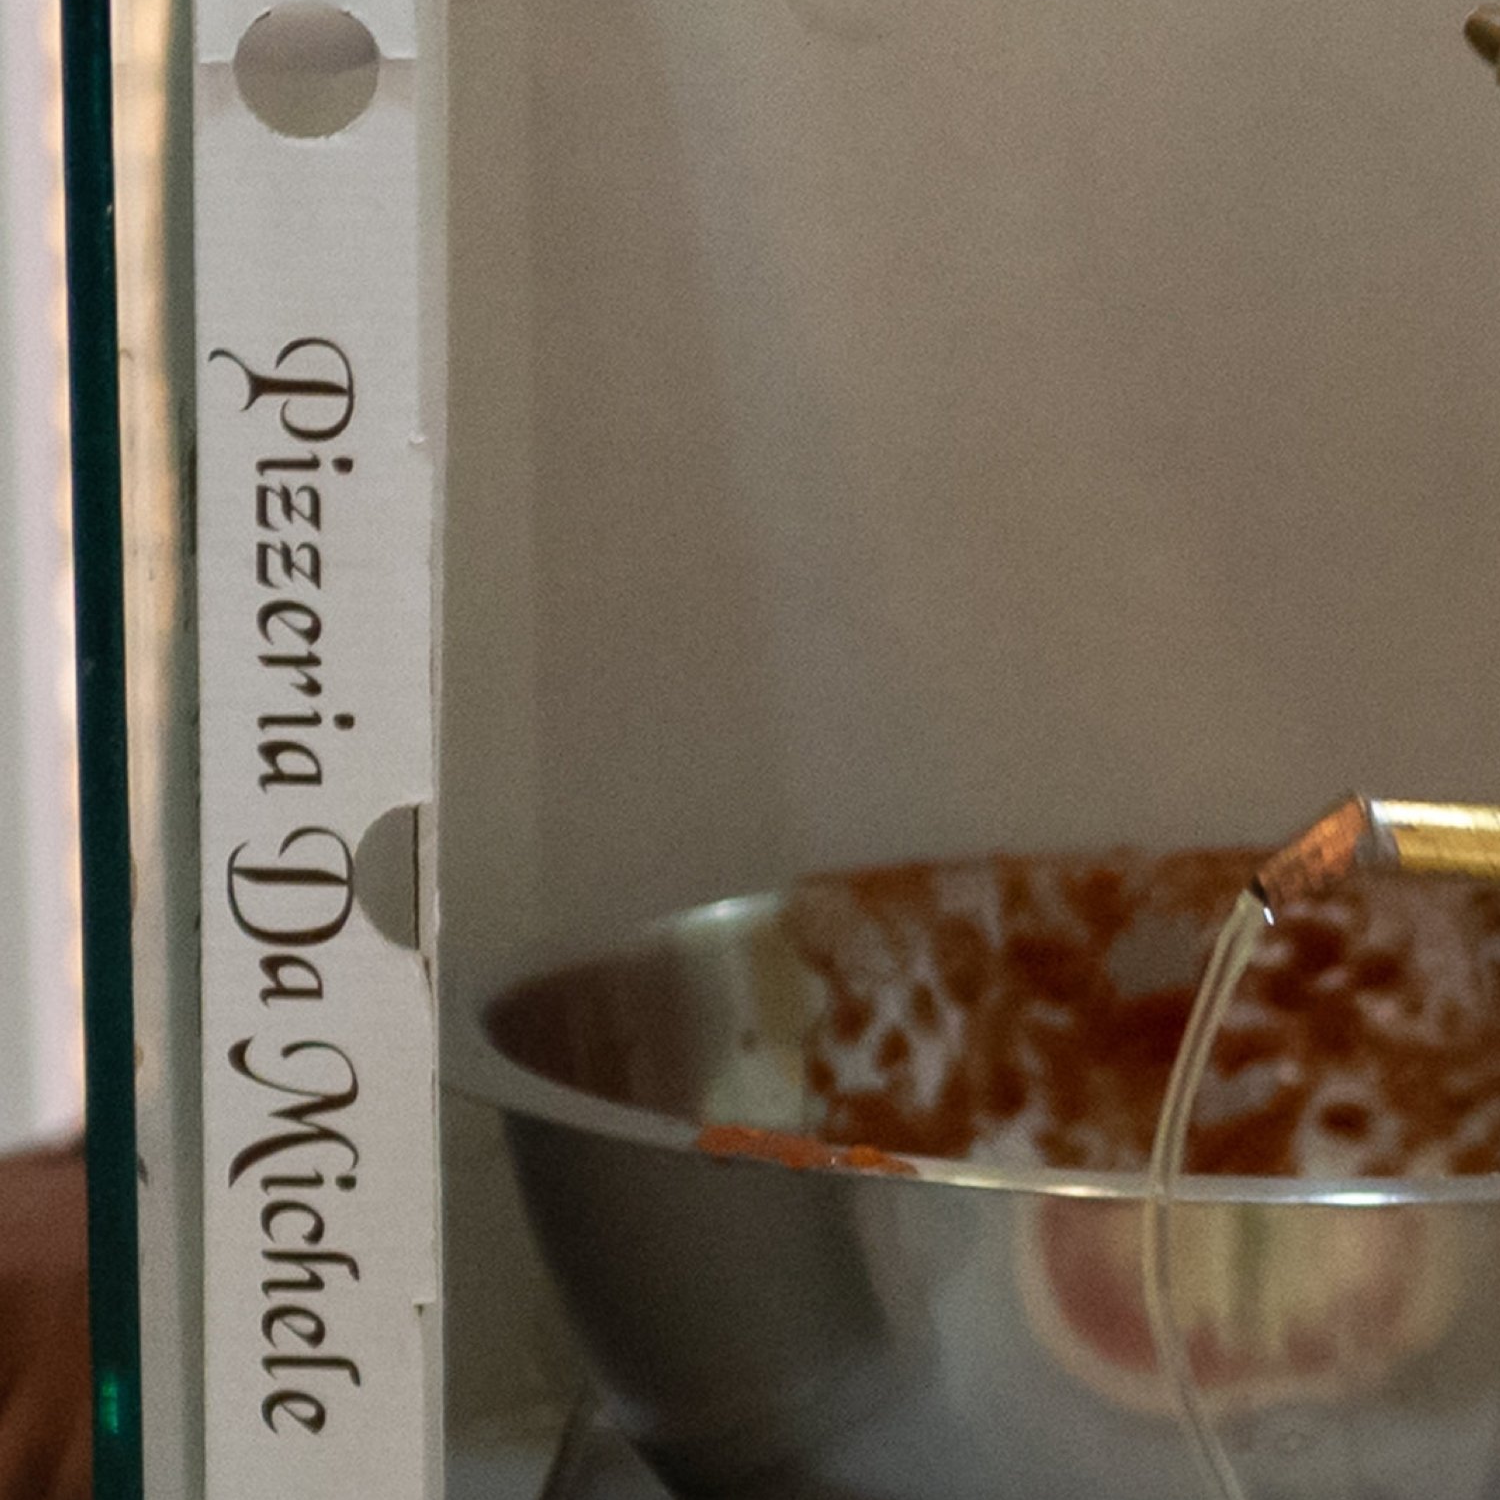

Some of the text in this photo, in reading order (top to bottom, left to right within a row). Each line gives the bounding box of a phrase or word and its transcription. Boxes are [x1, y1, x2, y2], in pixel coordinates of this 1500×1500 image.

[208, 336, 361, 1435] Pizzeria Da Michele
